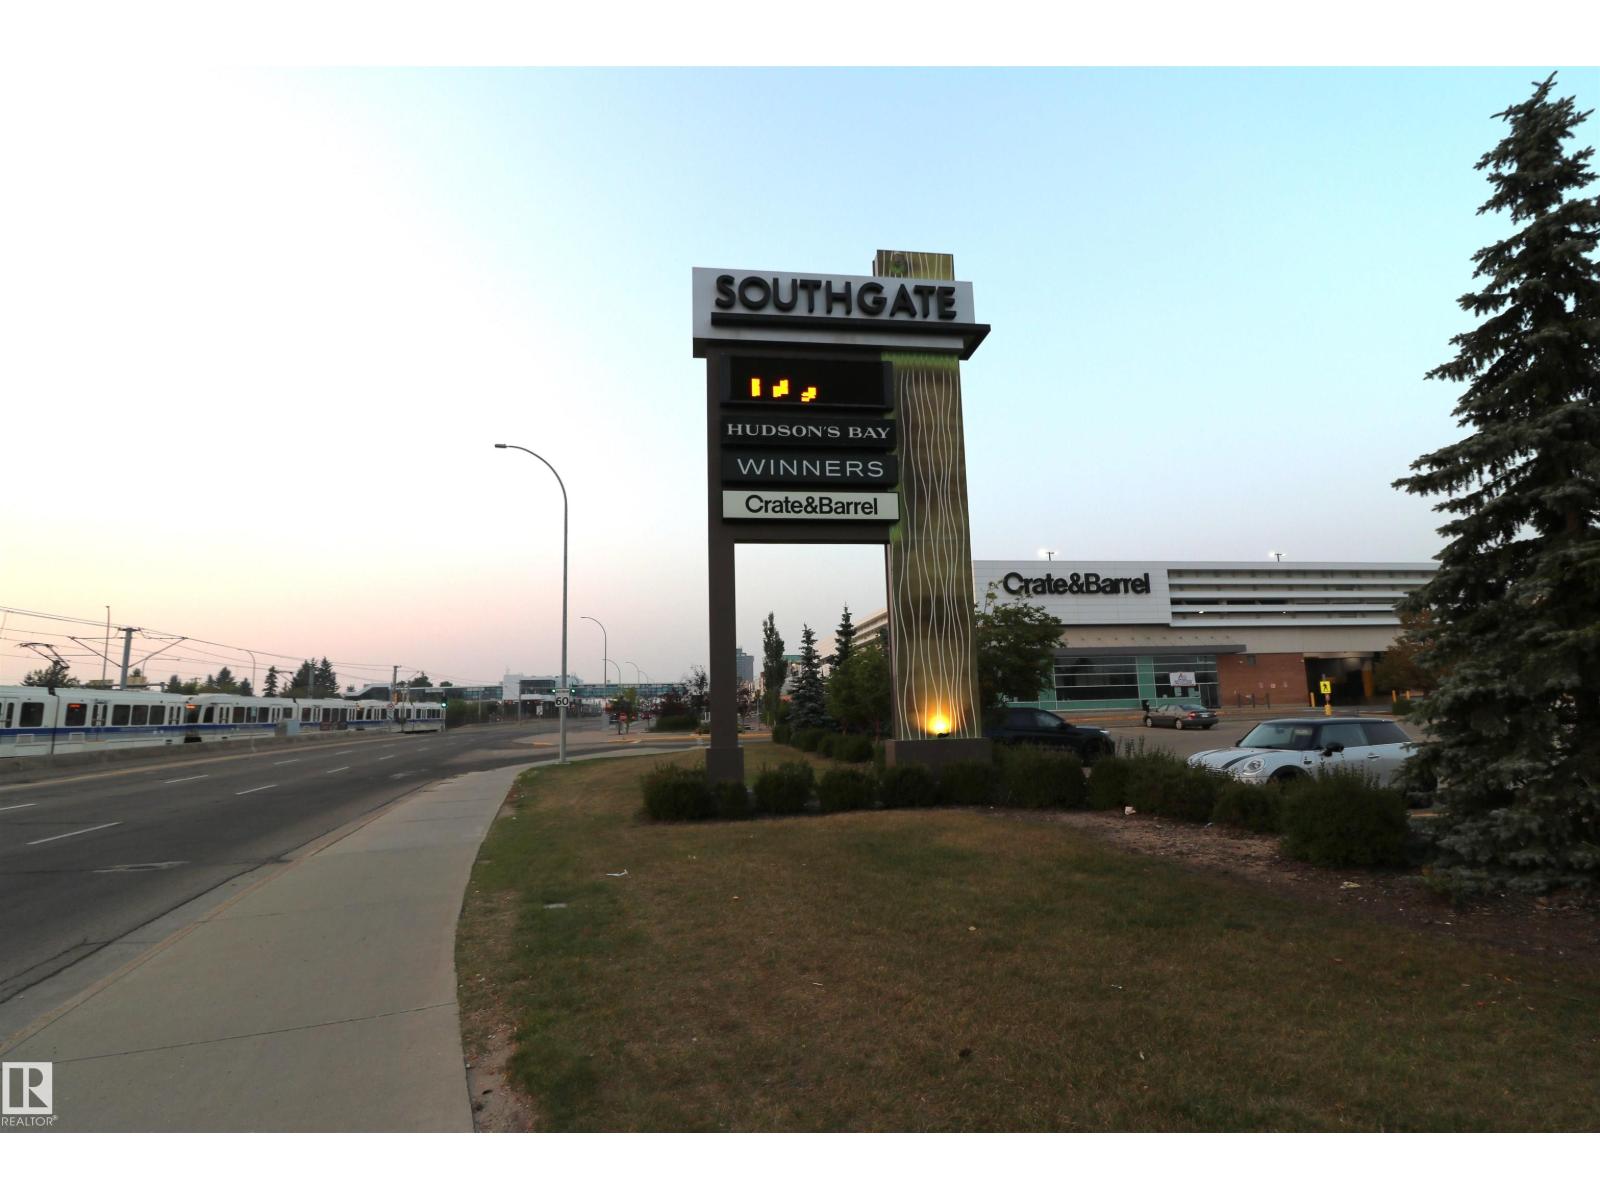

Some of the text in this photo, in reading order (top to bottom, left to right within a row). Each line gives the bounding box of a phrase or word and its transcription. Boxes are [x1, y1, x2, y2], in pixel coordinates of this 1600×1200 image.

[715, 274, 957, 321] SOUTHGATE
[727, 423, 891, 439] HUDSON'S BAY
[737, 458, 884, 478] WINNERS
[745, 494, 878, 515] Crate&Barrel
[1002, 572, 1151, 595] Crate&Barrel
[555, 696, 569, 706] 60
